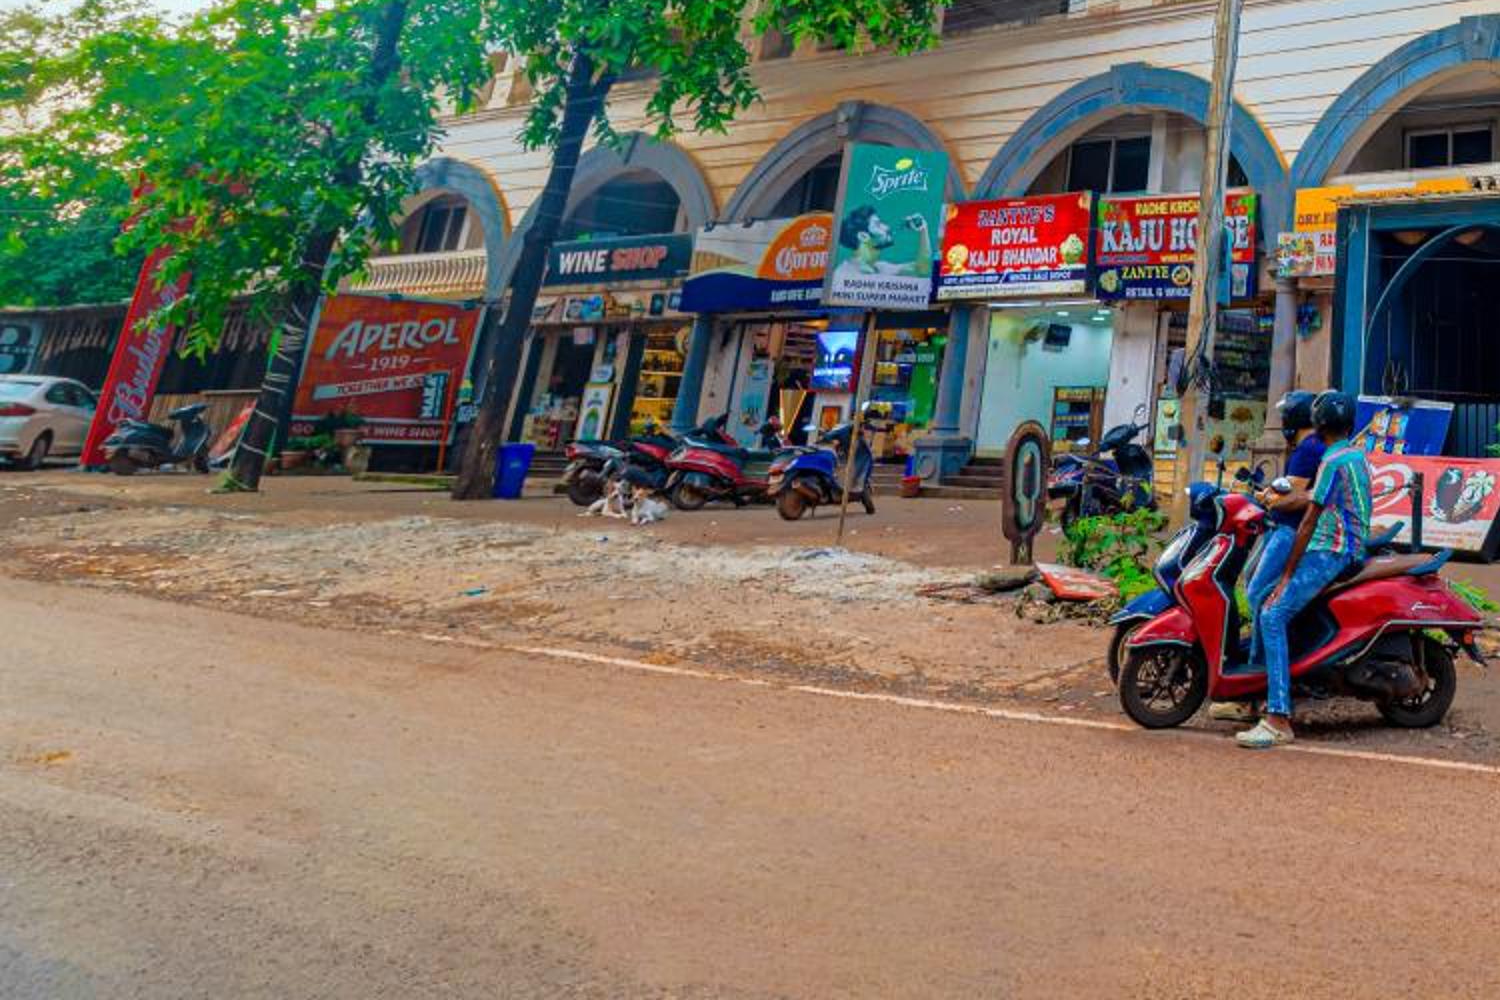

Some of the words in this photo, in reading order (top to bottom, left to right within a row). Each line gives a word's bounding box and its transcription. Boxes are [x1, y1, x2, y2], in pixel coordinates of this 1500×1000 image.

[871, 169, 923, 193] Sprite
[1136, 202, 1169, 215] RADHE
[991, 226, 1038, 245] ROYAL
[1102, 219, 1164, 252] KAJU
[559, 249, 608, 274] WINE
[611, 246, 667, 270] SHOP
[968, 249, 1000, 267] KAJU
[1001, 246, 1057, 265] BHANDAR
[1122, 265, 1170, 279] ZANTYE
[325, 317, 460, 360] APEROL
[369, 355, 411, 371] 1919
